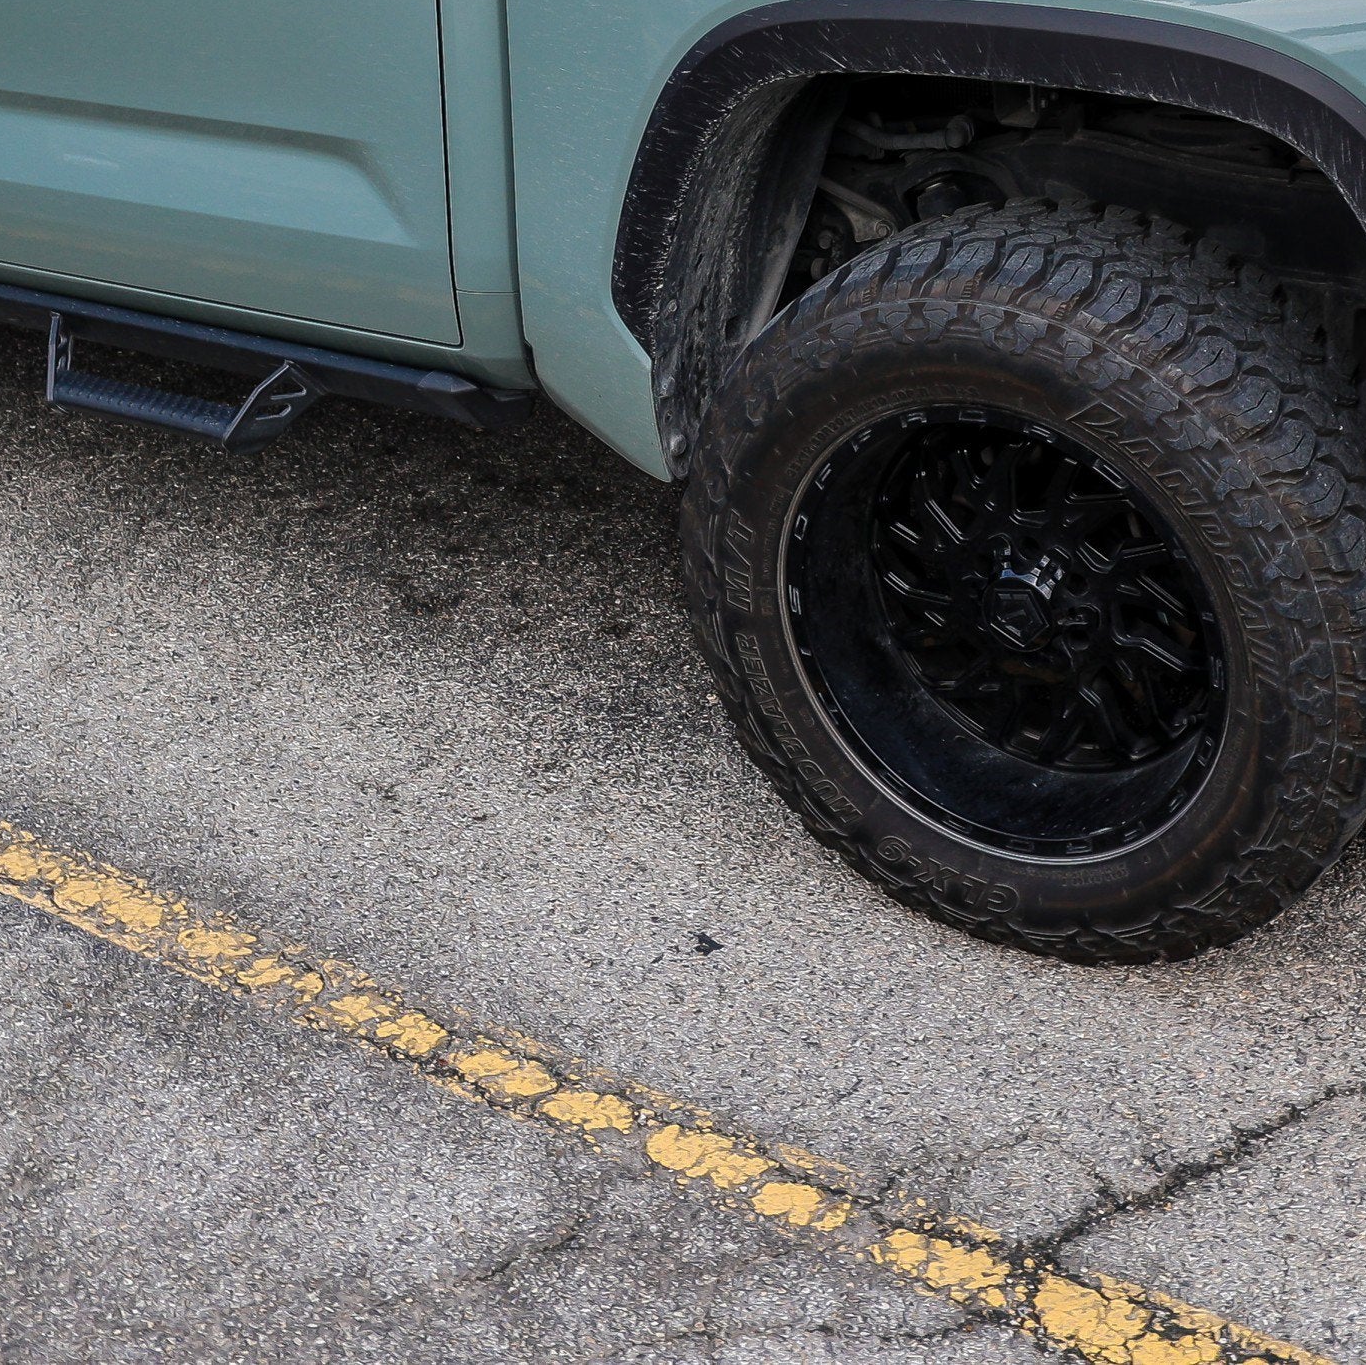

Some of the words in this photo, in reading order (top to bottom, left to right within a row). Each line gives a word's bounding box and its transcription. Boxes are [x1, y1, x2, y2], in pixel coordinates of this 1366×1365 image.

[723, 506, 756, 615] M/T
[1065, 398, 1283, 693] LANDSAIL
[735, 631, 867, 828] MUDBLAZER
[874, 832, 1021, 915] CLX-9
